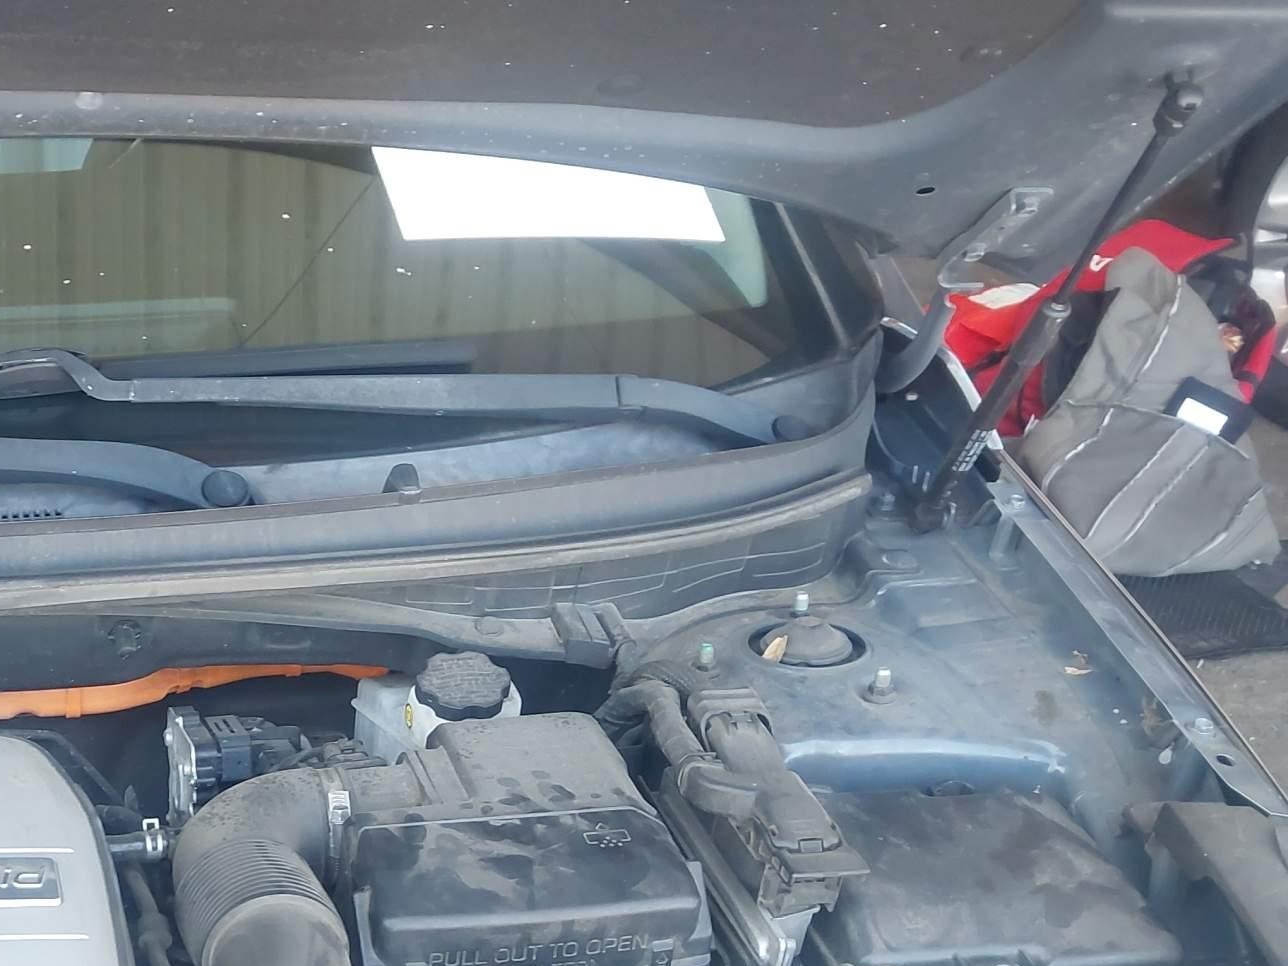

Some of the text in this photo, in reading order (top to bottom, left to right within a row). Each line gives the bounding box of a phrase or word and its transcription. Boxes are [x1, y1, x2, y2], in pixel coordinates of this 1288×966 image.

[494, 944, 544, 964] OUT
[548, 941, 578, 959] TO
[585, 935, 649, 956] OPEN
